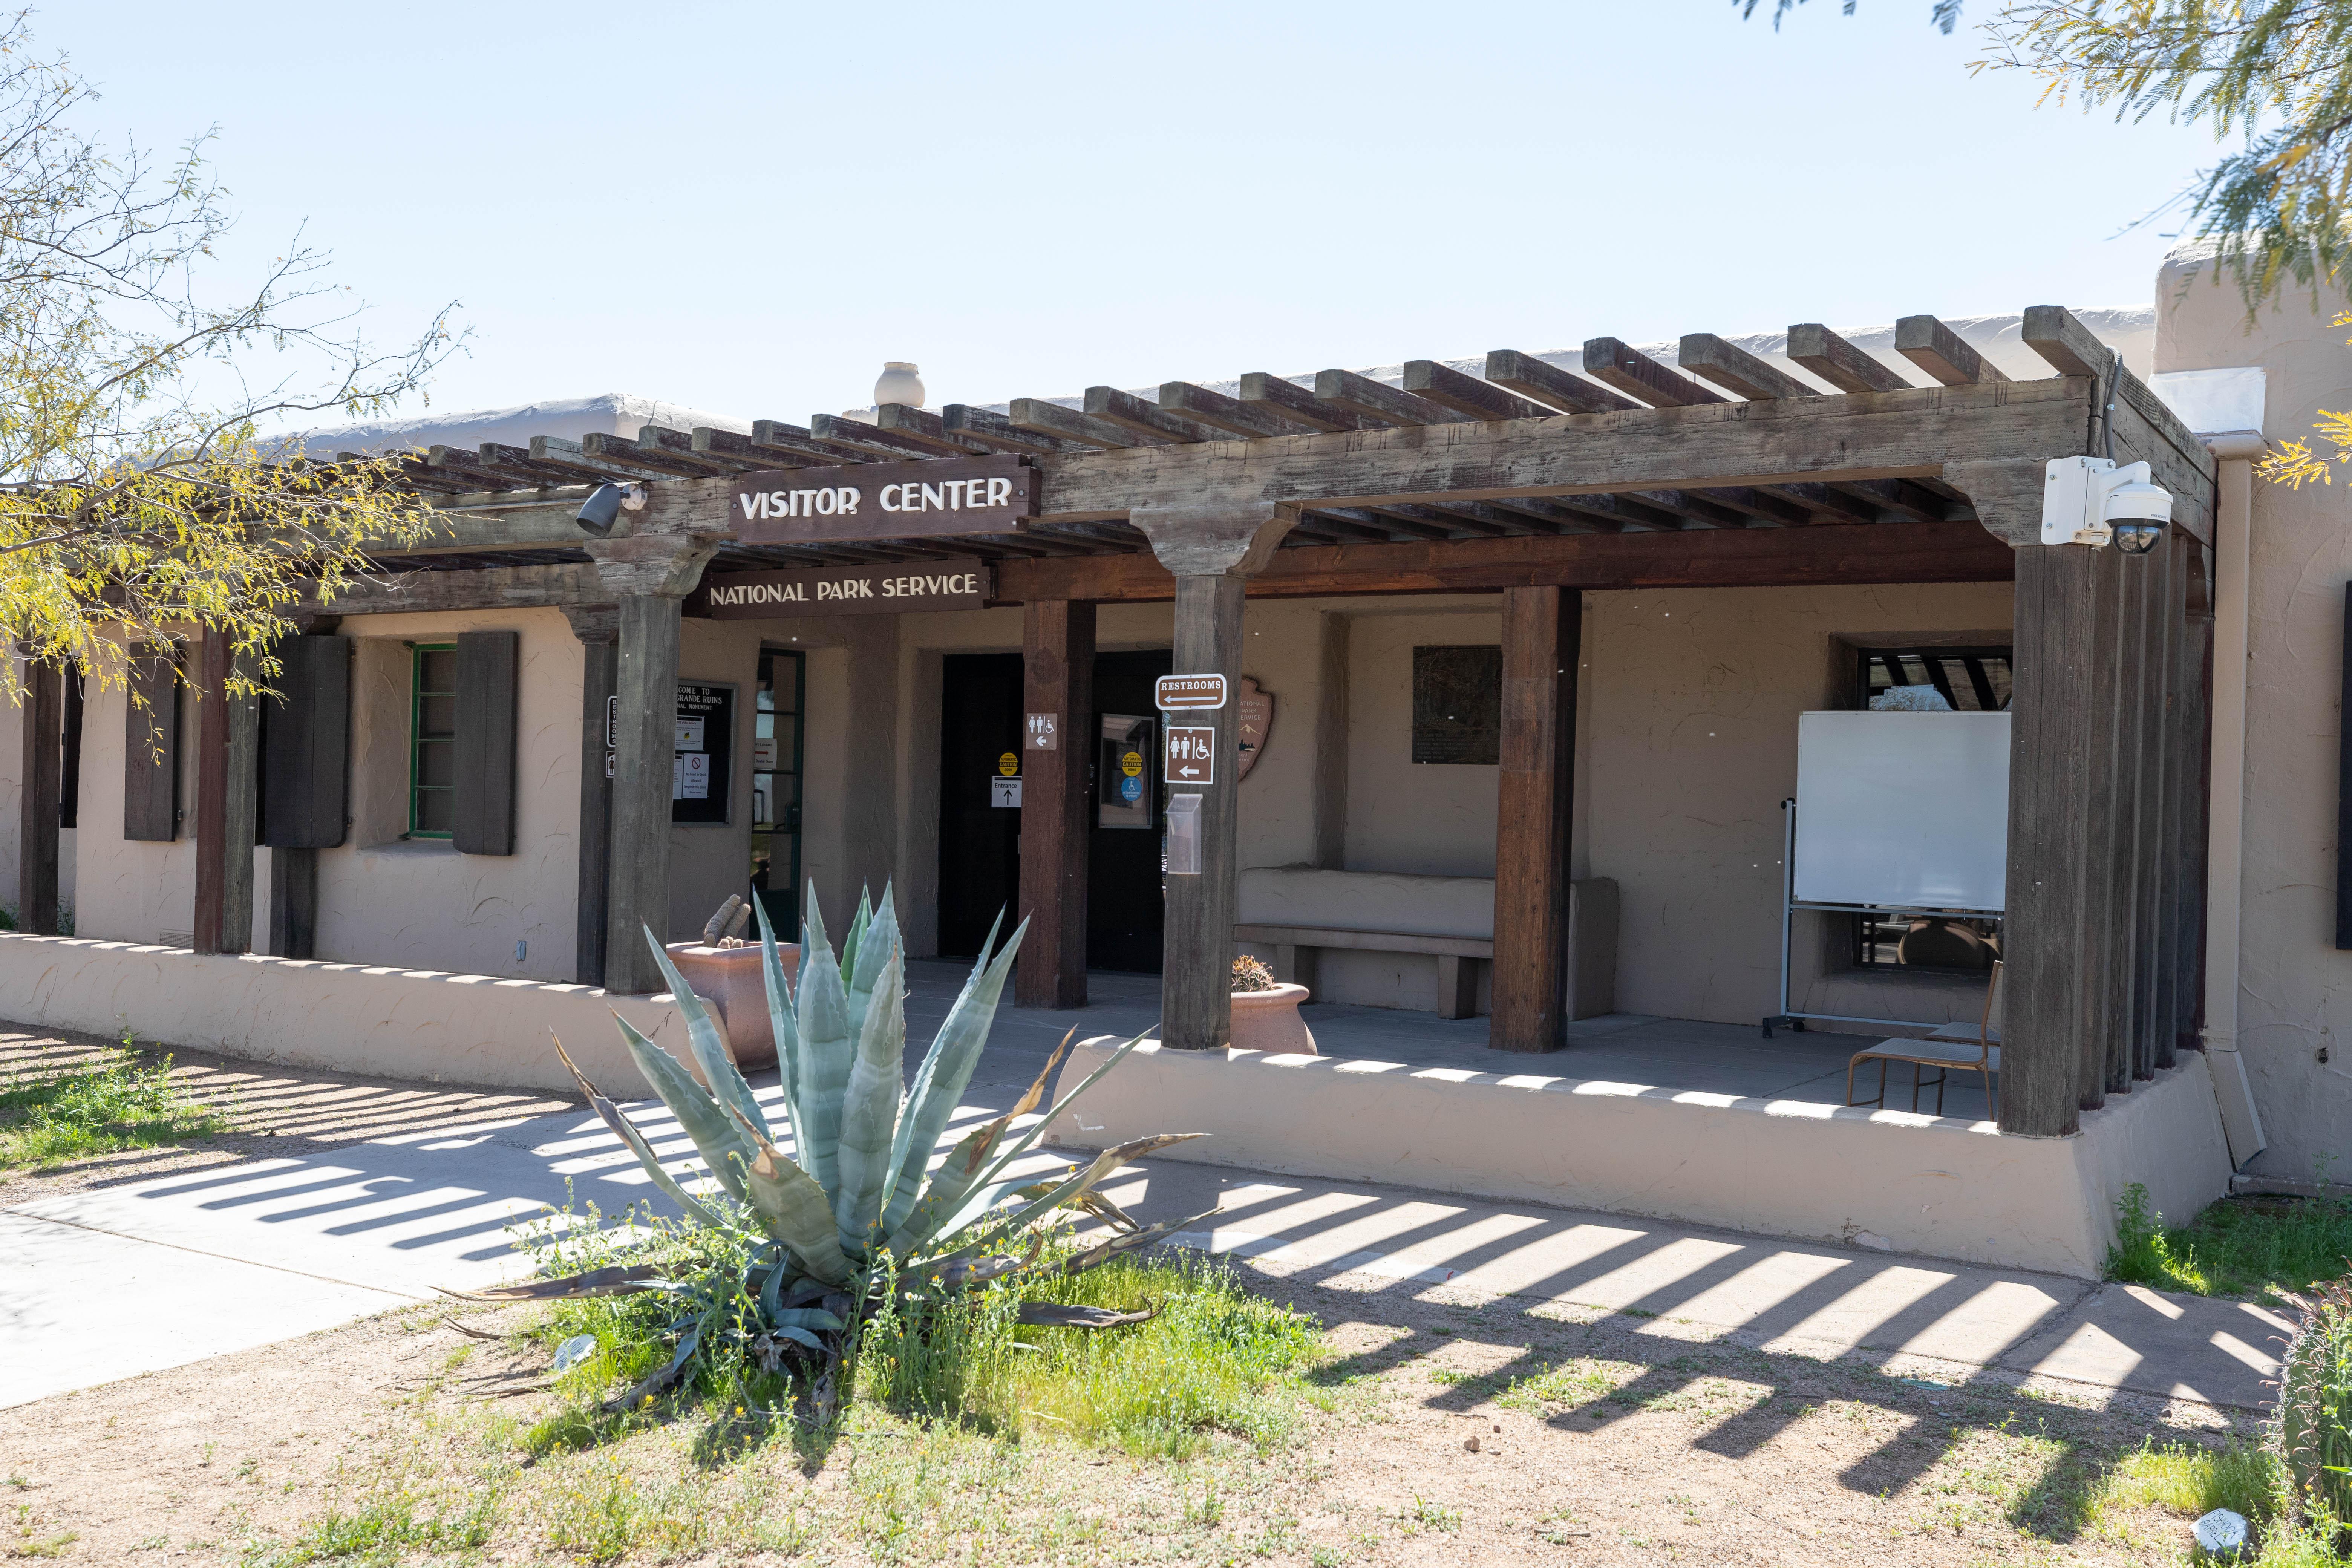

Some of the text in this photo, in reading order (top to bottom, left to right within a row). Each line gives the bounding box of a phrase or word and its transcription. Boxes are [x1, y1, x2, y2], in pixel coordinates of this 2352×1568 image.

[740, 478, 1013, 520] VISITOR CENTER
[710, 574, 979, 605] NATIONAL PARK SERVICE
[1161, 681, 1221, 691] RESTROOMS
[677, 694, 722, 704] GRANDE RUINS
[2199, 1519, 2222, 1540] BARREL
